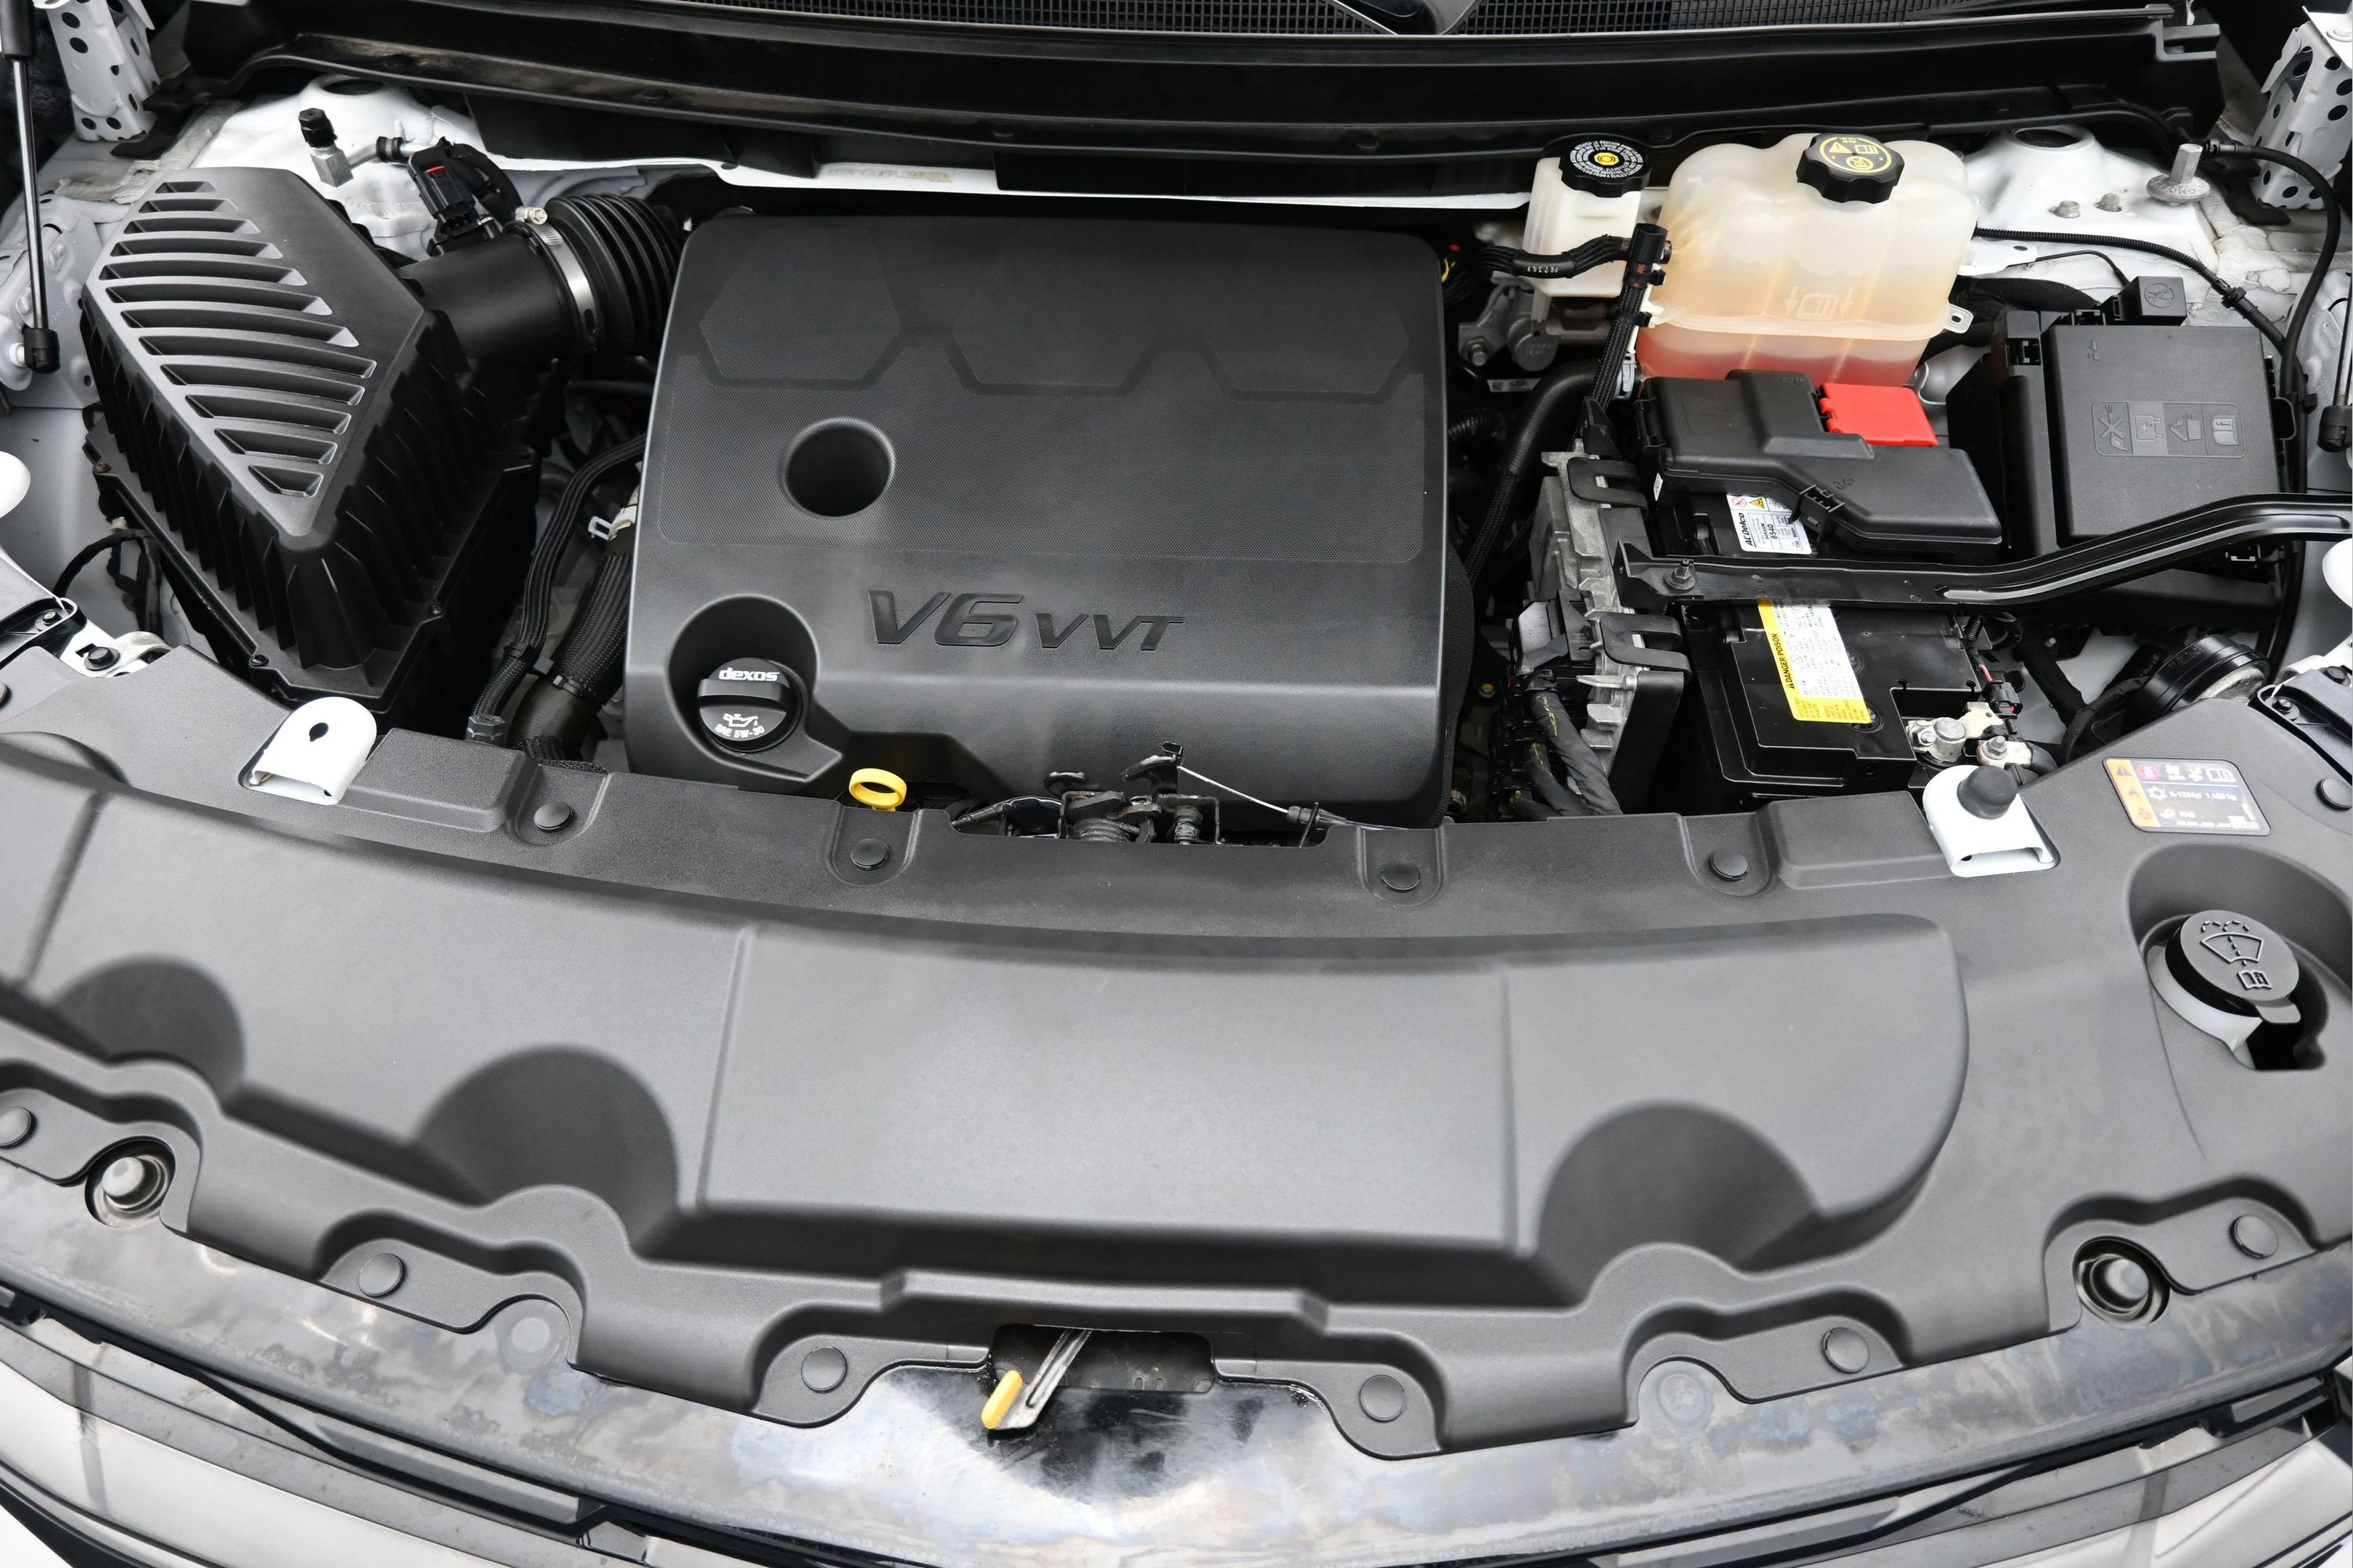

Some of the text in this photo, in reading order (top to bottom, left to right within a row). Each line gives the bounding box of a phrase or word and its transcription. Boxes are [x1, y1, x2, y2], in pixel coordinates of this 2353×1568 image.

[1767, 523, 1778, 539] 8540
[868, 590, 1185, 651] V6 VVT
[1771, 634, 1793, 684] DANGER POISON
[719, 667, 780, 682] dexos
[714, 724, 765, 738] SAE 5W-30
